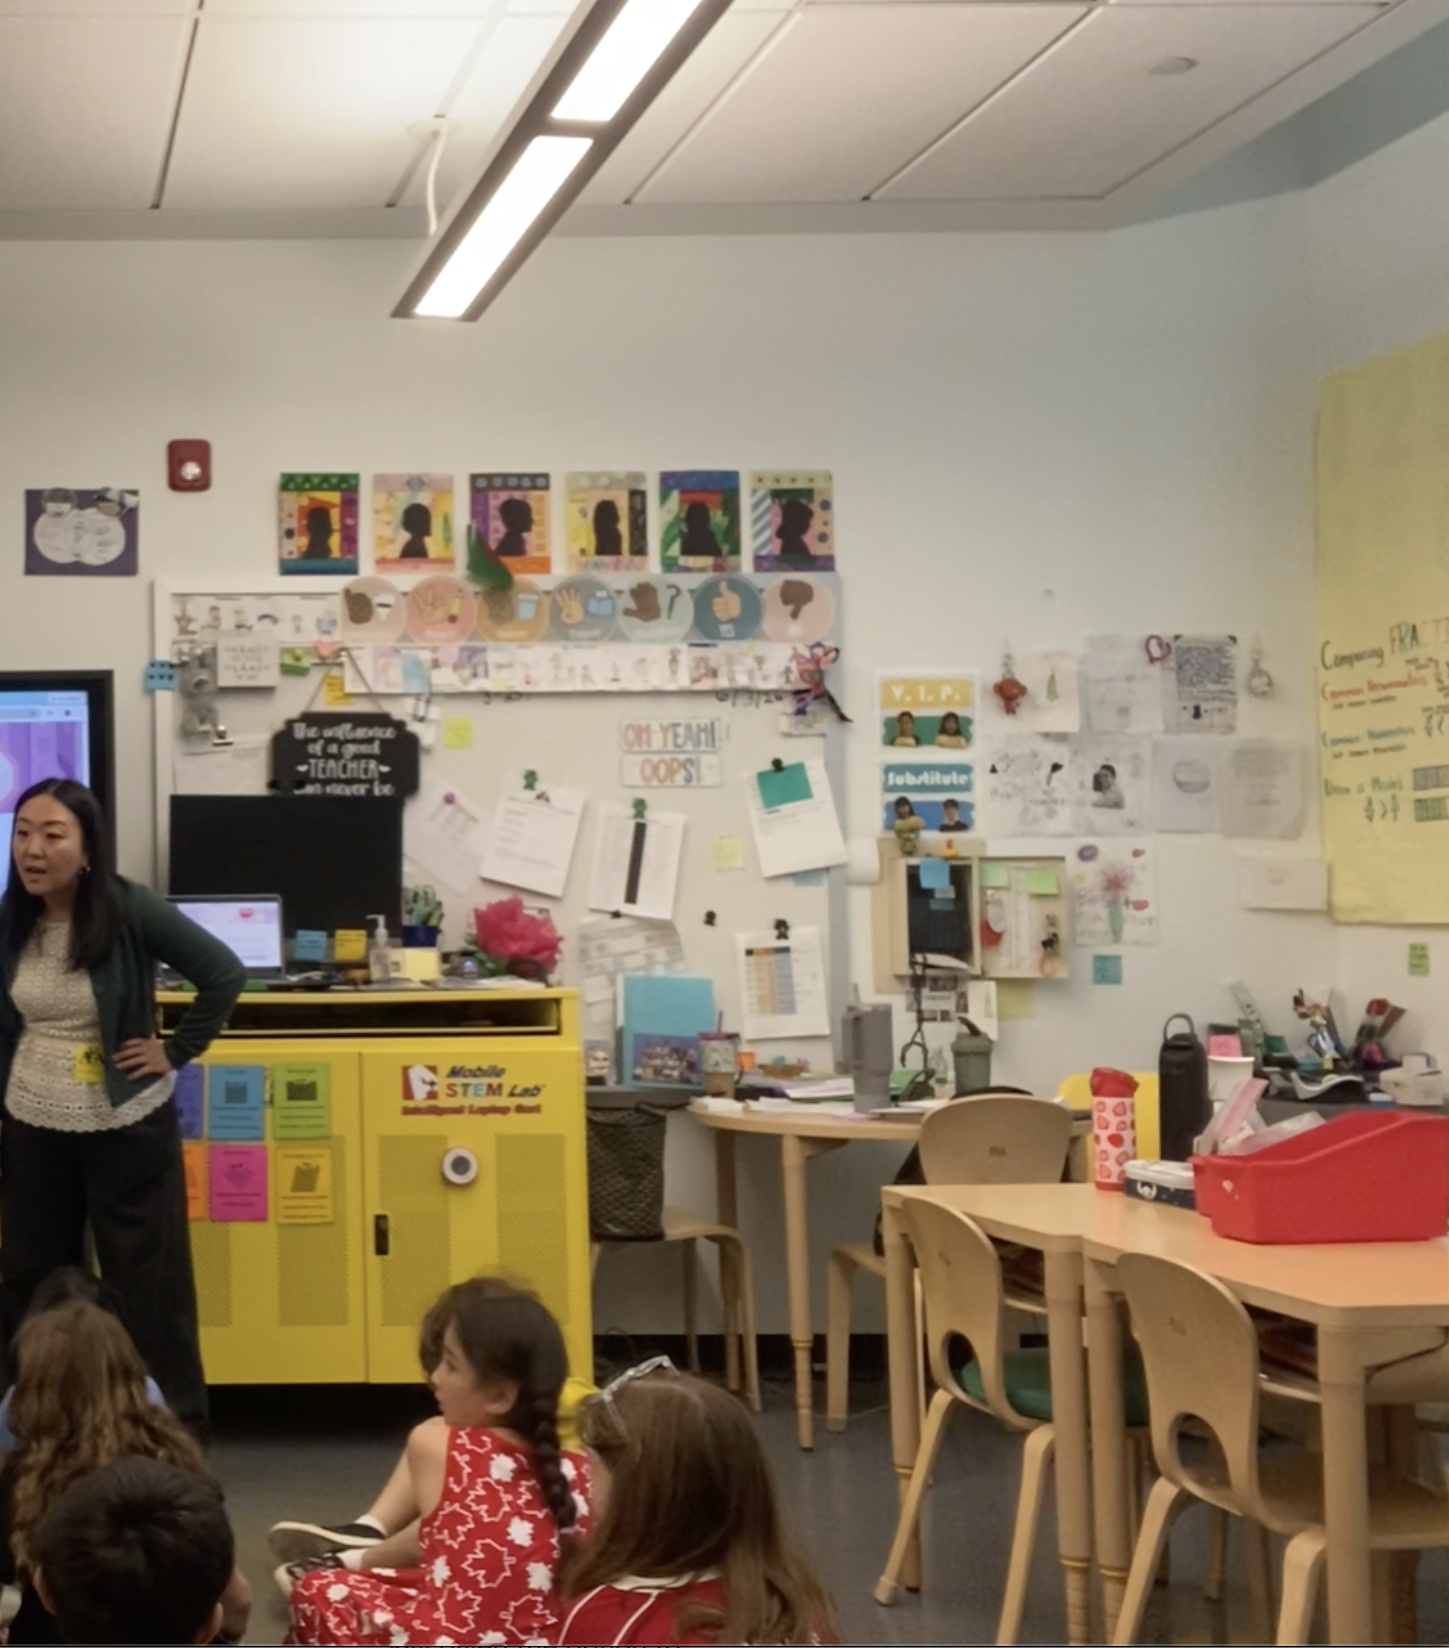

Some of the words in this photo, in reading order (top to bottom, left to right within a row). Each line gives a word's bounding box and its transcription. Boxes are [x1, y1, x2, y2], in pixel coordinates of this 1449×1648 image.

[293, 723, 320, 739] The
[323, 723, 397, 740] influence
[624, 723, 651, 749] OH
[659, 721, 715, 749] YEAH!
[307, 740, 325, 756] of
[327, 743, 338, 754] a
[341, 740, 380, 758] good
[308, 759, 380, 779] TEACHER
[640, 756, 700, 784] OOPS!
[887, 770, 969, 785] Substitute
[325, 784, 370, 795] never
[374, 781, 396, 796] be
[446, 1065, 506, 1079] Mobile
[445, 1083, 503, 1098] STEM
[468, 1105, 511, 1116] Laptop
